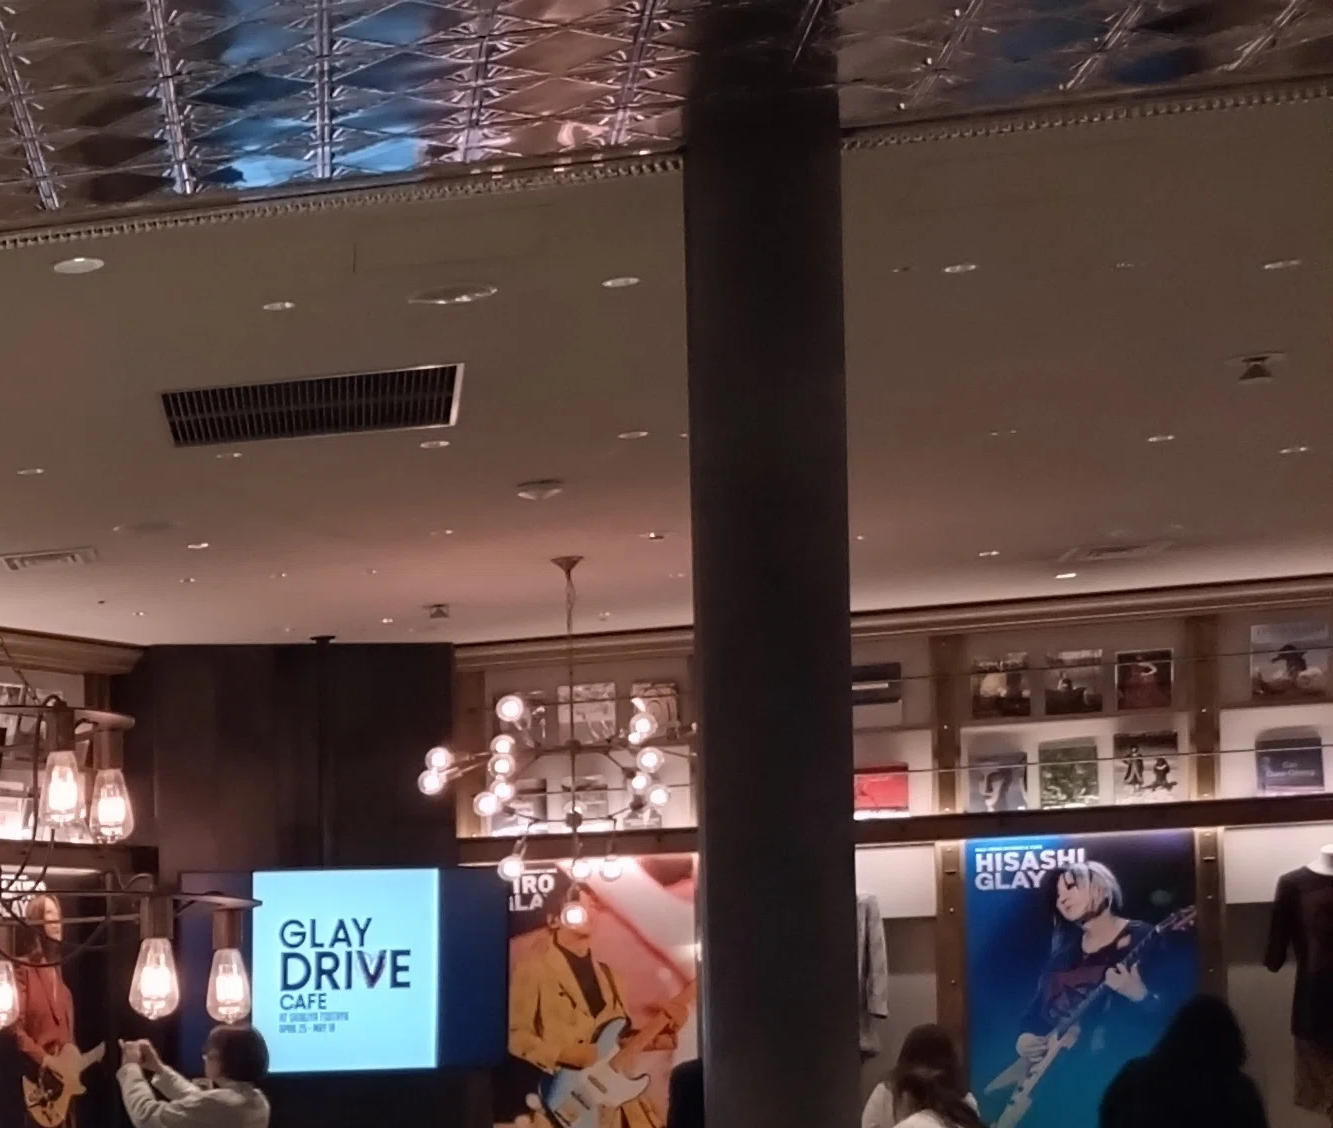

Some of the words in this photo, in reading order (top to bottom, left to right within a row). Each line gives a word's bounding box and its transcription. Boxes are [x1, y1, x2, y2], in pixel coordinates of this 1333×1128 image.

[975, 848, 1085, 873] HISASHI
[974, 870, 1046, 890] GLAY
[279, 917, 372, 949] GLAY
[280, 949, 411, 991] DRIVE
[280, 993, 327, 1010] CAFE
